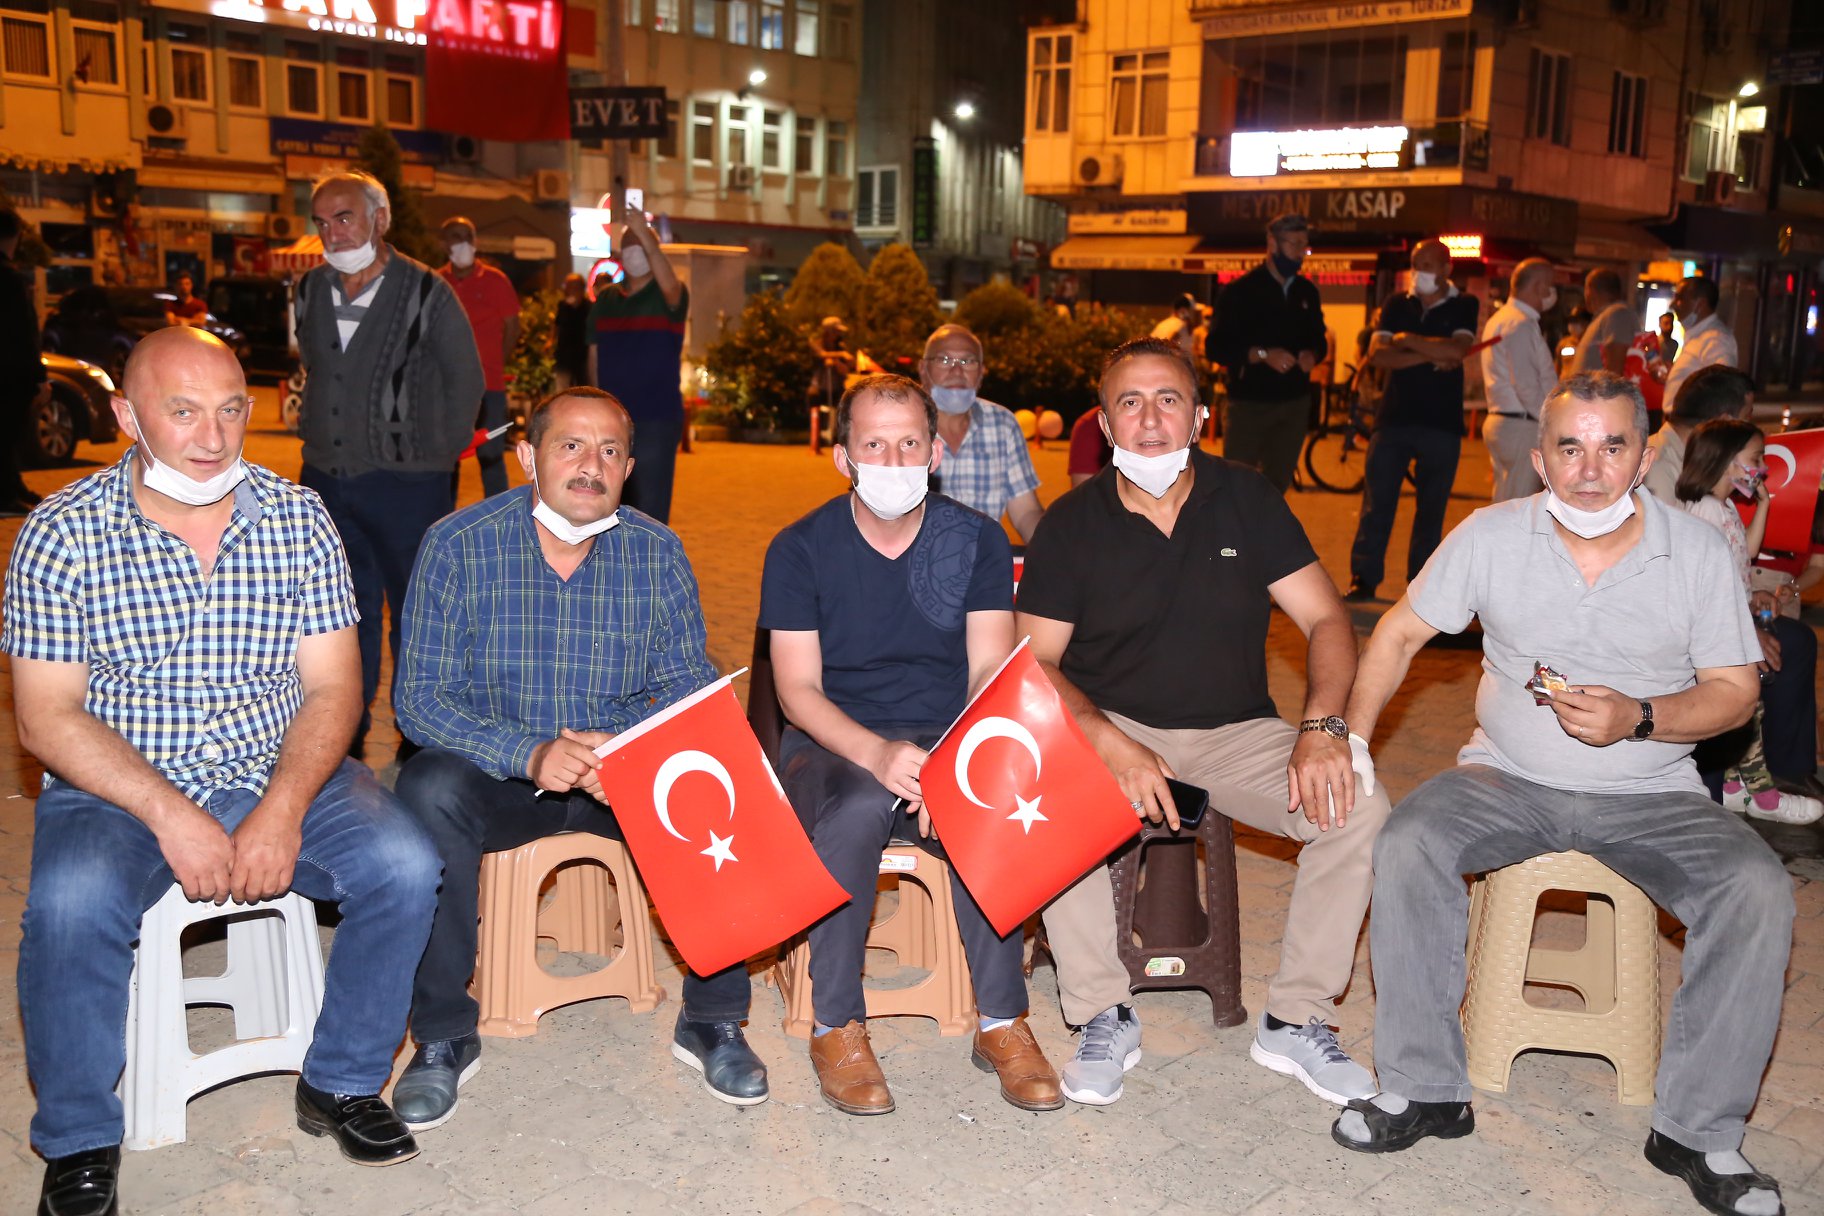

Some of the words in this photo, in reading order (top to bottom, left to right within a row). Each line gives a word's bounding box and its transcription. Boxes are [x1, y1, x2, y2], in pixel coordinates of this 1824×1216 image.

[397, 0, 555, 48] PARTİ
[1337, 5, 1379, 22] EMLAK
[574, 98, 663, 127] EVET
[1221, 192, 1311, 219] MEYDAN
[1327, 190, 1405, 219] KASAP
